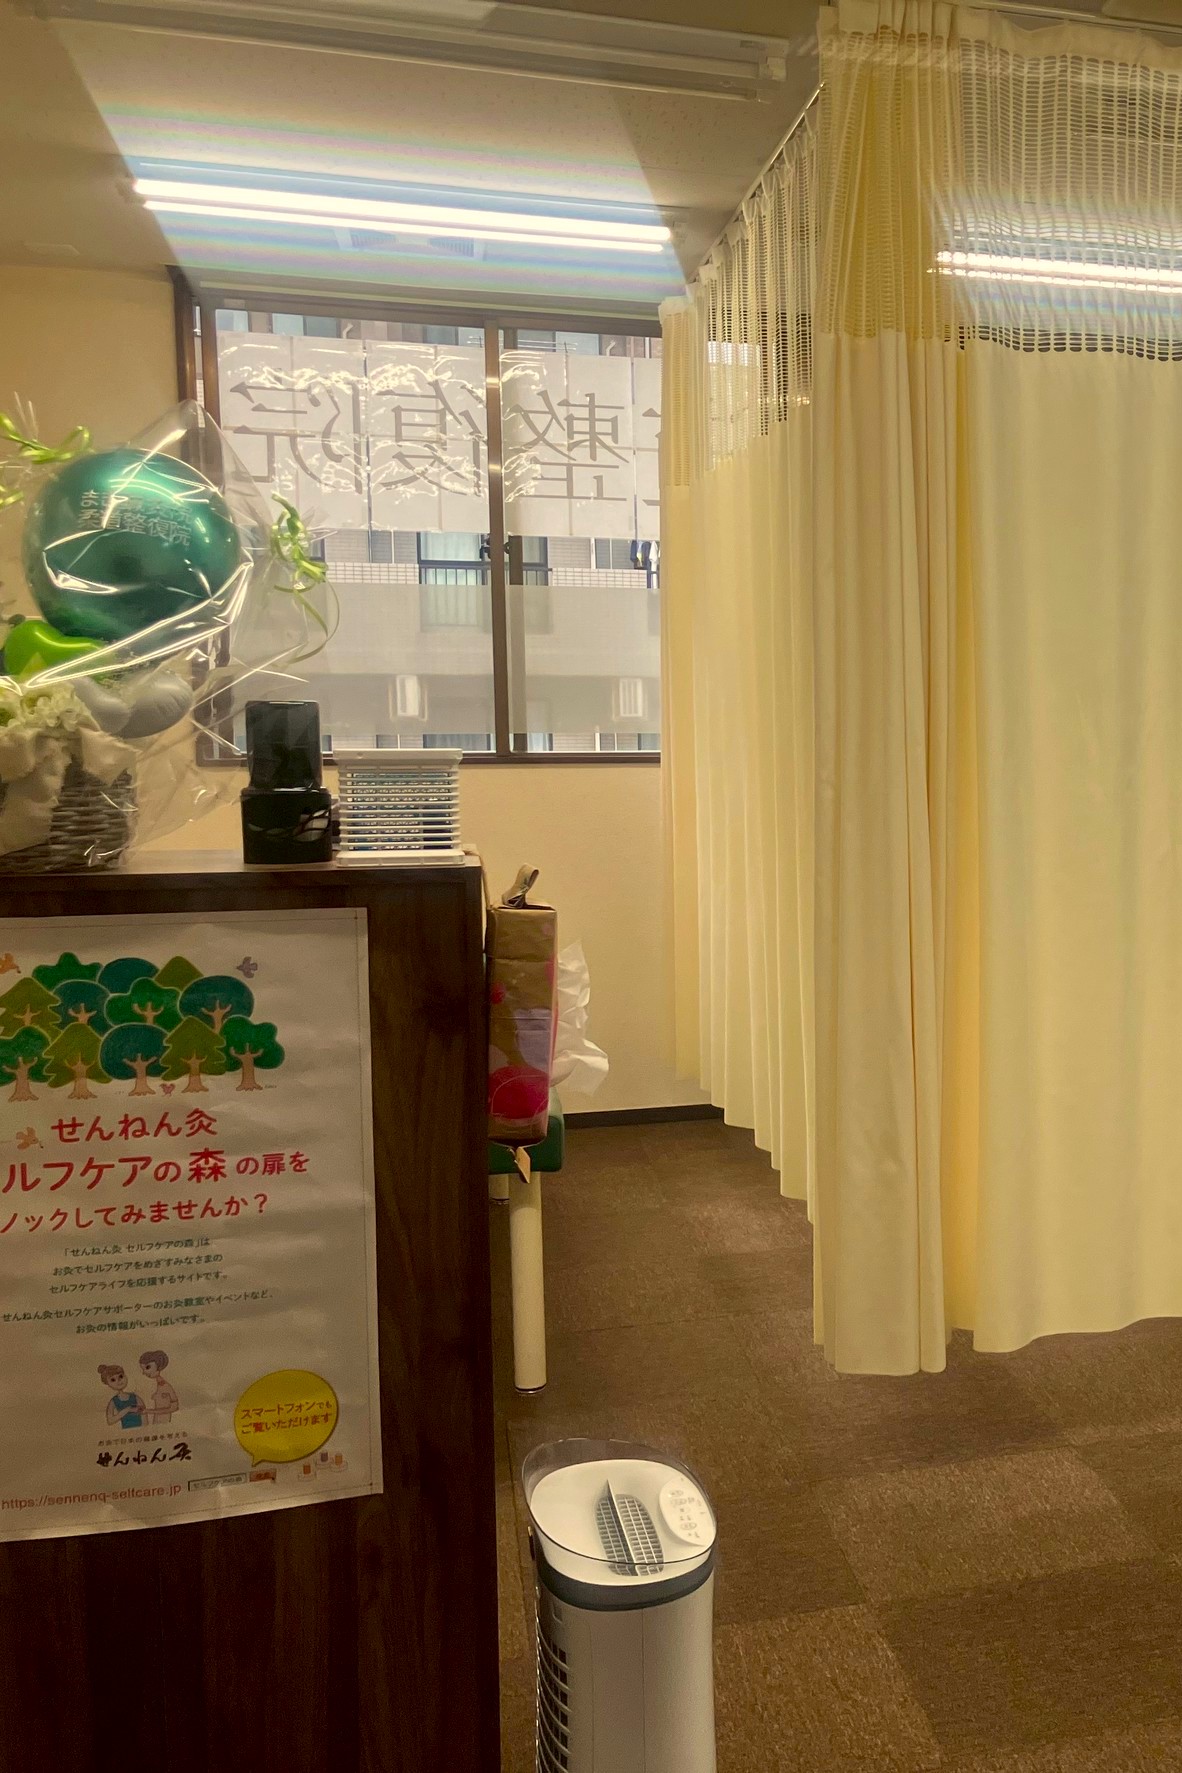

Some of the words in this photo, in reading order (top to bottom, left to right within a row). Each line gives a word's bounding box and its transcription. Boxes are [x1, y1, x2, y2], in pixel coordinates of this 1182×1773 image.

[51, 1107, 218, 1143] せんねん灸
[52, 1252, 224, 1277] お灸でセルフケアをめざすみなさまの
[48, 1271, 228, 1295] セルフケアライフを応援するサイトです。
[240, 1400, 333, 1420] スマートフォンでも
[240, 1411, 333, 1435] ご覧いただけます
[96, 1441, 193, 1467] せんねん灸
[1, 1483, 183, 1511] https://sennenq-selfcare.jp
